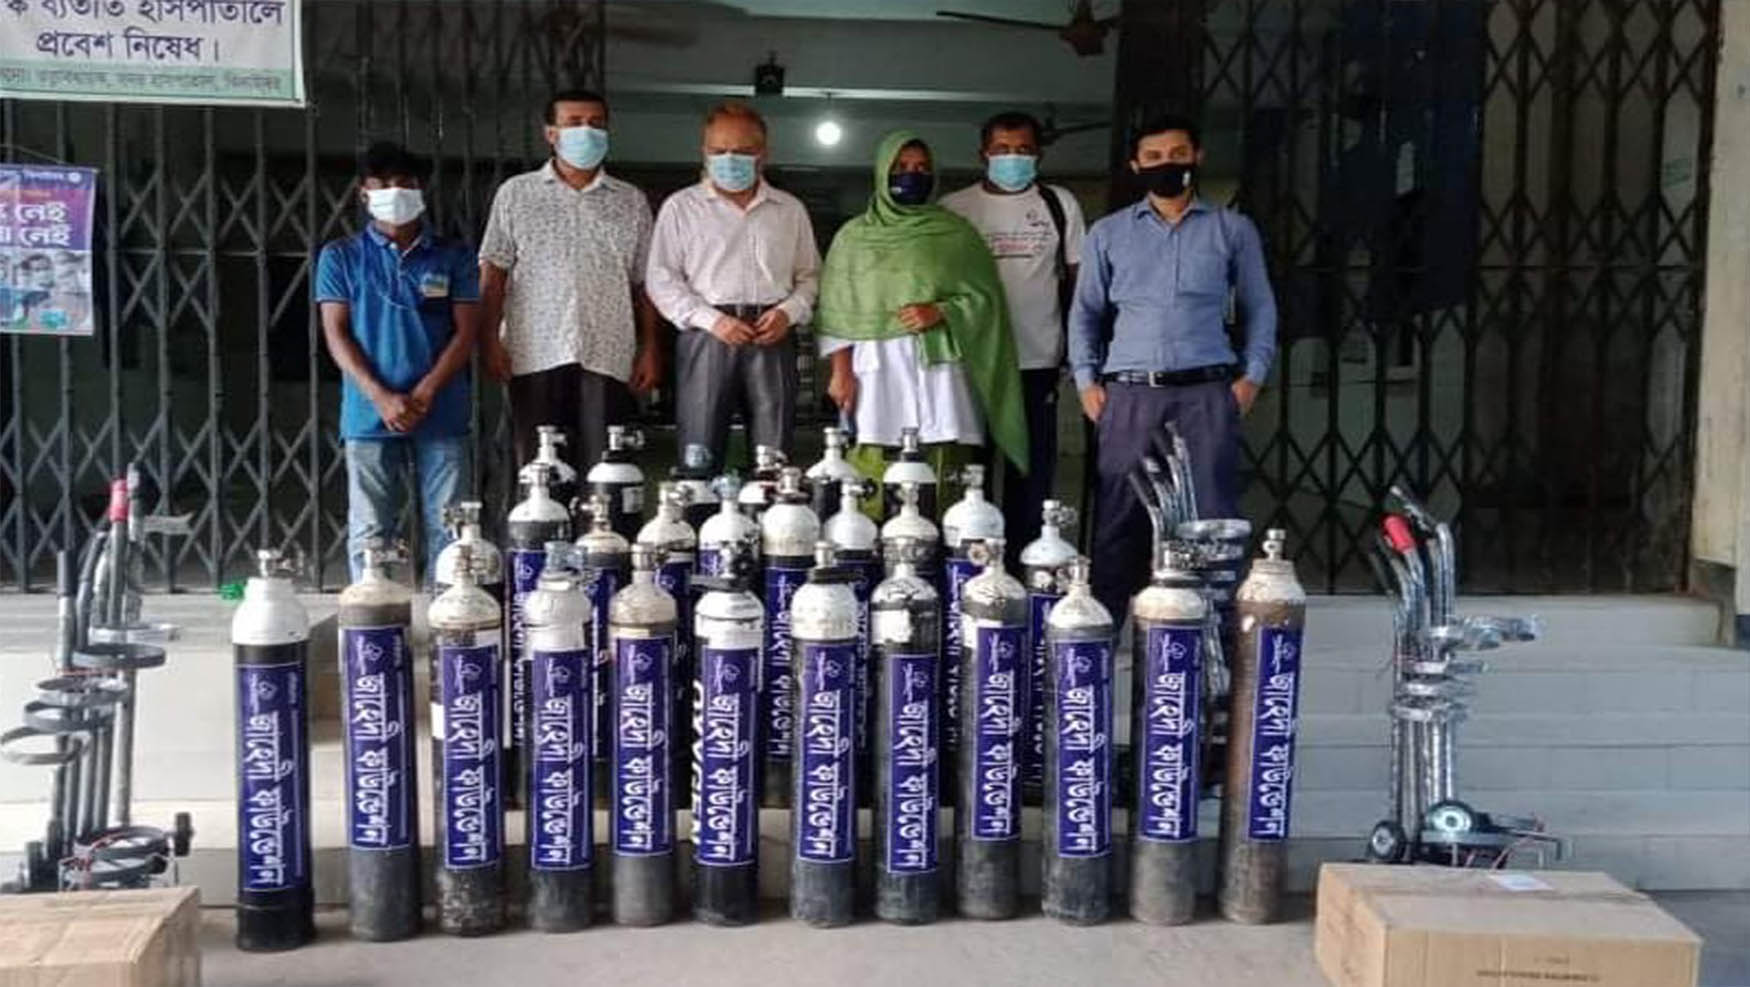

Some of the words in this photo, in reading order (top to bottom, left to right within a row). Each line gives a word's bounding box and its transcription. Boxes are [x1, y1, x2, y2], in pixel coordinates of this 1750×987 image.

[36, 30, 113, 59] প্রবেশ
[124, 26, 204, 61] নিষেধ
[352, 673, 399, 742] জাহেদী
[448, 691, 494, 760] জাহেদী
[539, 695, 583, 763] জাহেদী
[620, 683, 664, 750] জাহেদী
[706, 693, 751, 761] জাহেদী
[806, 690, 849, 757] জাহেদী
[894, 700, 936, 767] জাহেদী
[981, 670, 1021, 737] জাহেদী
[1061, 685, 1106, 753] জাহেদী
[1149, 672, 1194, 738] জাহেদী
[1258, 672, 1299, 738] জাহেদী
[245, 711, 294, 782] জাহেদী
[355, 748, 396, 844] ফাউন্ডেশন
[452, 765, 494, 860] ফাউন্ডেশন
[539, 769, 582, 864] ফাউন্ডেশন
[620, 755, 662, 850] ফাউন্ডেশন
[706, 766, 747, 860] ফাউন্ডেশন
[805, 762, 847, 857] ফাউন্ডেশন
[894, 772, 934, 868] ফাউন্ডেশন
[976, 742, 1020, 834] ফাউন্ডেশন
[1063, 757, 1103, 851] ফাউন্ডেশন
[1147, 744, 1190, 838] ফাউন্ডেশন
[1253, 743, 1293, 837] ফাউন্ডেশন
[248, 786, 292, 884] ফাউন্ডেশন
